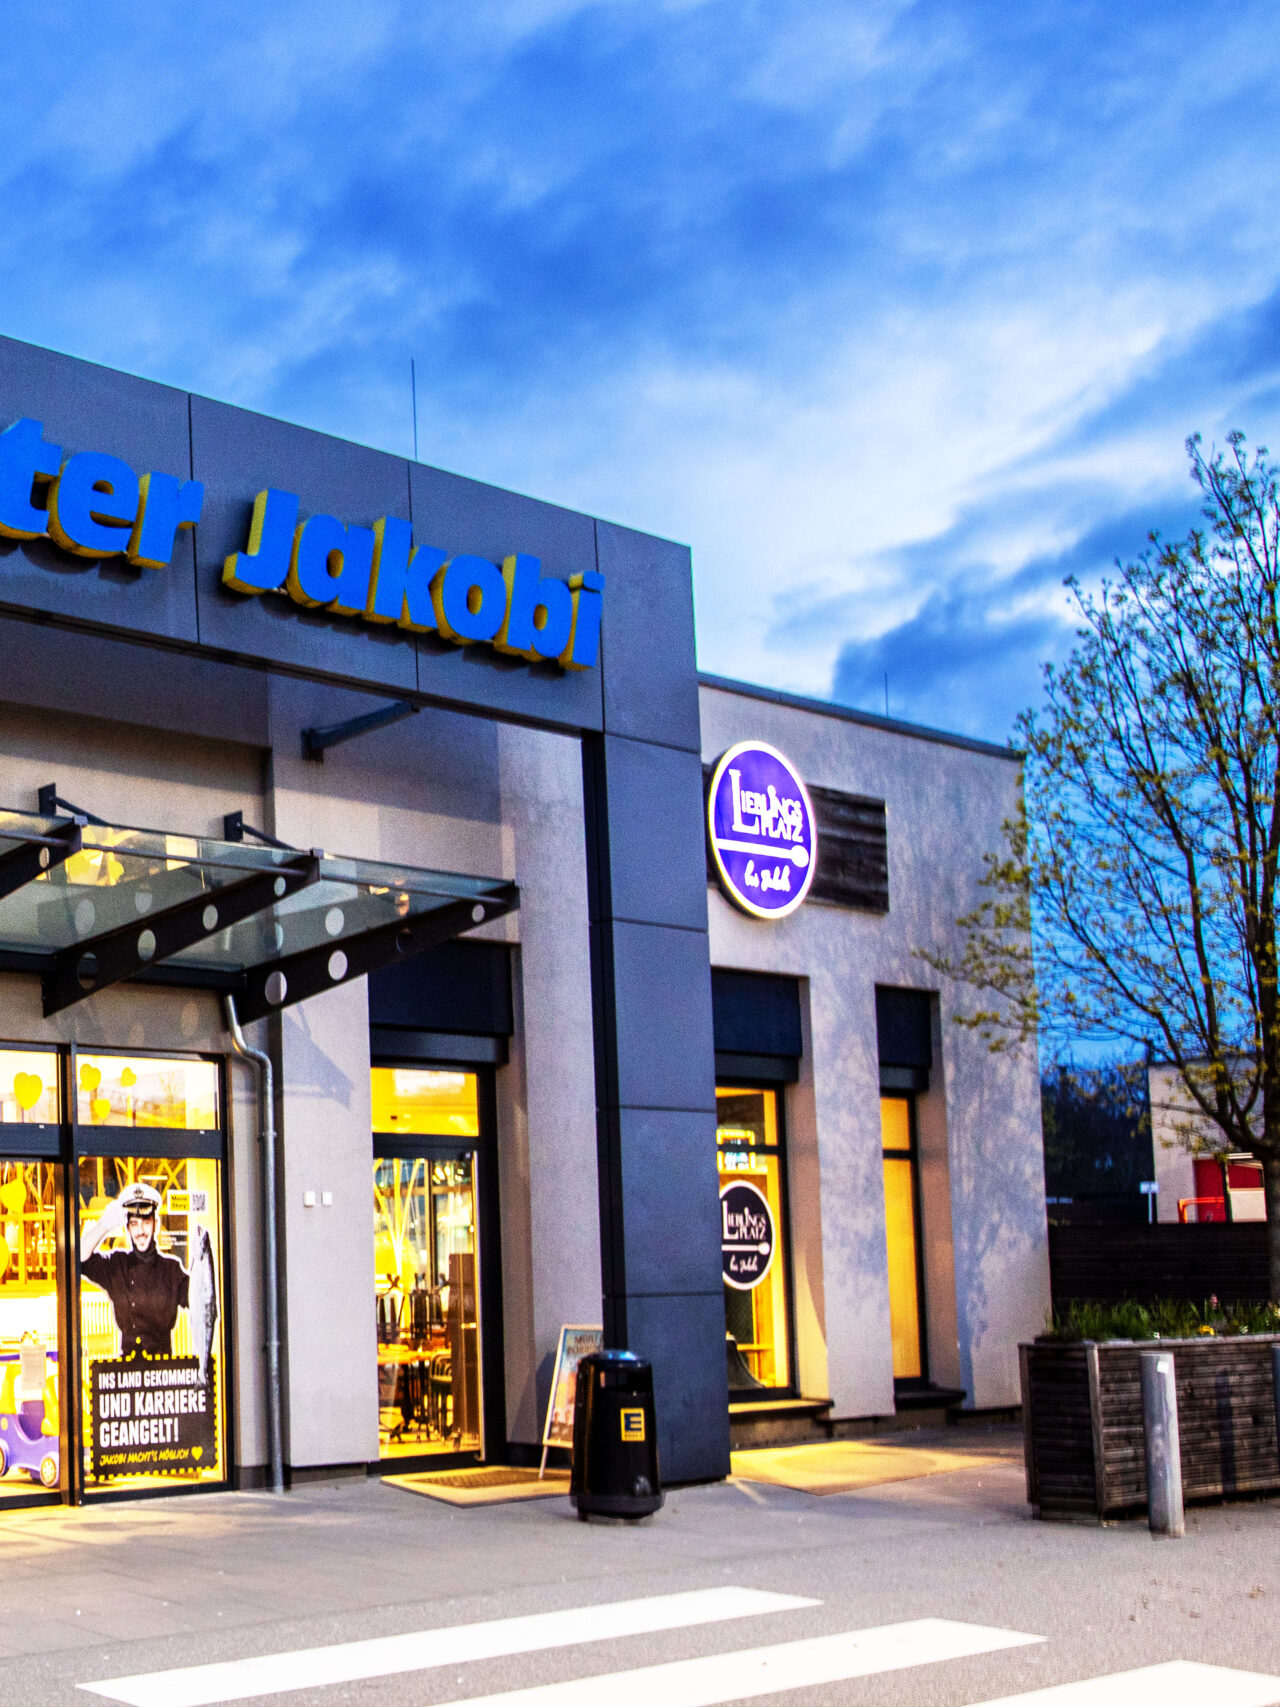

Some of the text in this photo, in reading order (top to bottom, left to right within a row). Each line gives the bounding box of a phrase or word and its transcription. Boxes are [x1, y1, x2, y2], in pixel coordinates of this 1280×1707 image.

[222, 488, 605, 672] Jakobi
[98, 1372, 116, 1389] INS
[117, 1371, 142, 1389] LAND
[99, 1388, 207, 1419] UND KARRIERE
[99, 1417, 180, 1448] GEANGELT!
